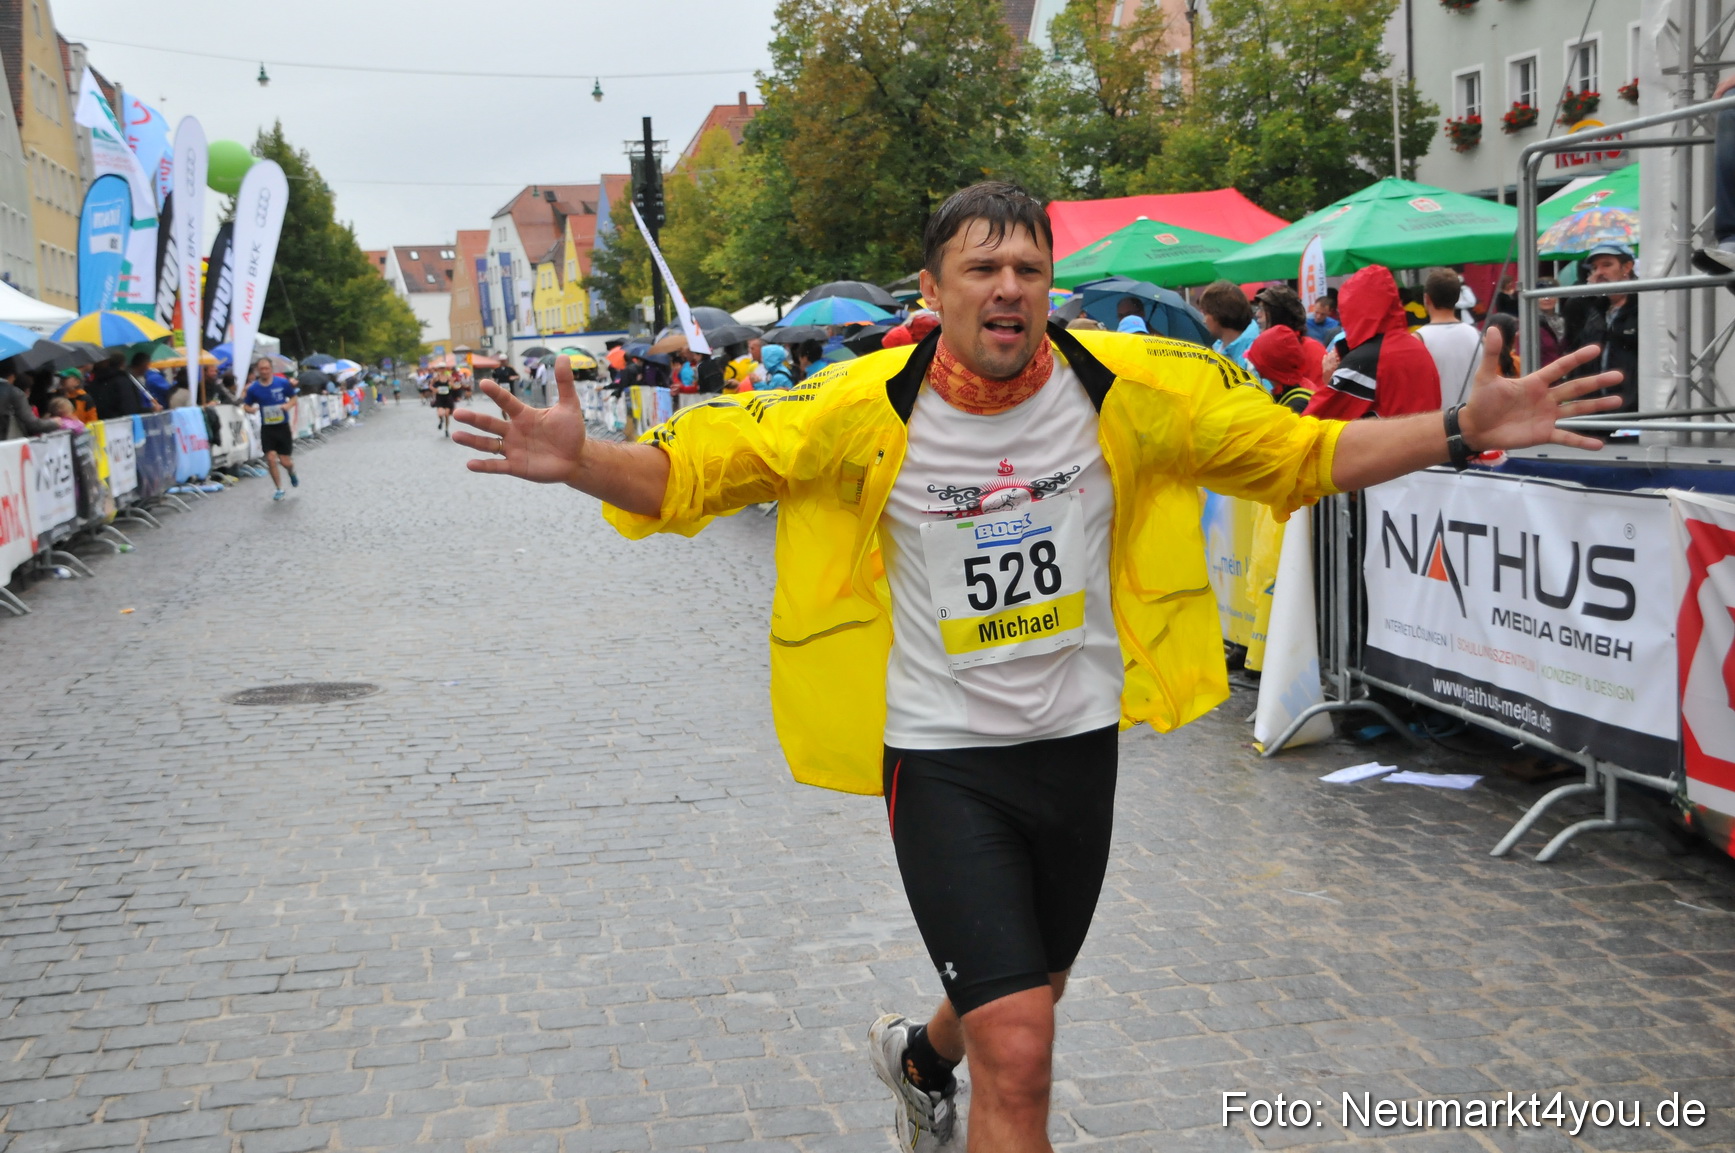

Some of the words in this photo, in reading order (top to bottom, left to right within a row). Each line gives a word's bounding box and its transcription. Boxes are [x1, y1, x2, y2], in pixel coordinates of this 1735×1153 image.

[186, 213, 196, 258] BKK
[248, 240, 262, 278] BKK
[187, 264, 197, 315] Audi
[242, 281, 256, 324] Audi
[975, 513, 1032, 540] BOCK
[964, 540, 1062, 611] 528
[1381, 508, 1637, 622] NATHUS
[978, 607, 1060, 643] Michael
[1491, 607, 1554, 642] MEDIA
[1559, 625, 1633, 662] GMBH
[1432, 677, 1552, 733] www.nathus-media.de
[1540, 664, 1582, 686] KONZEPT
[1594, 679, 1635, 702] DESIGN
